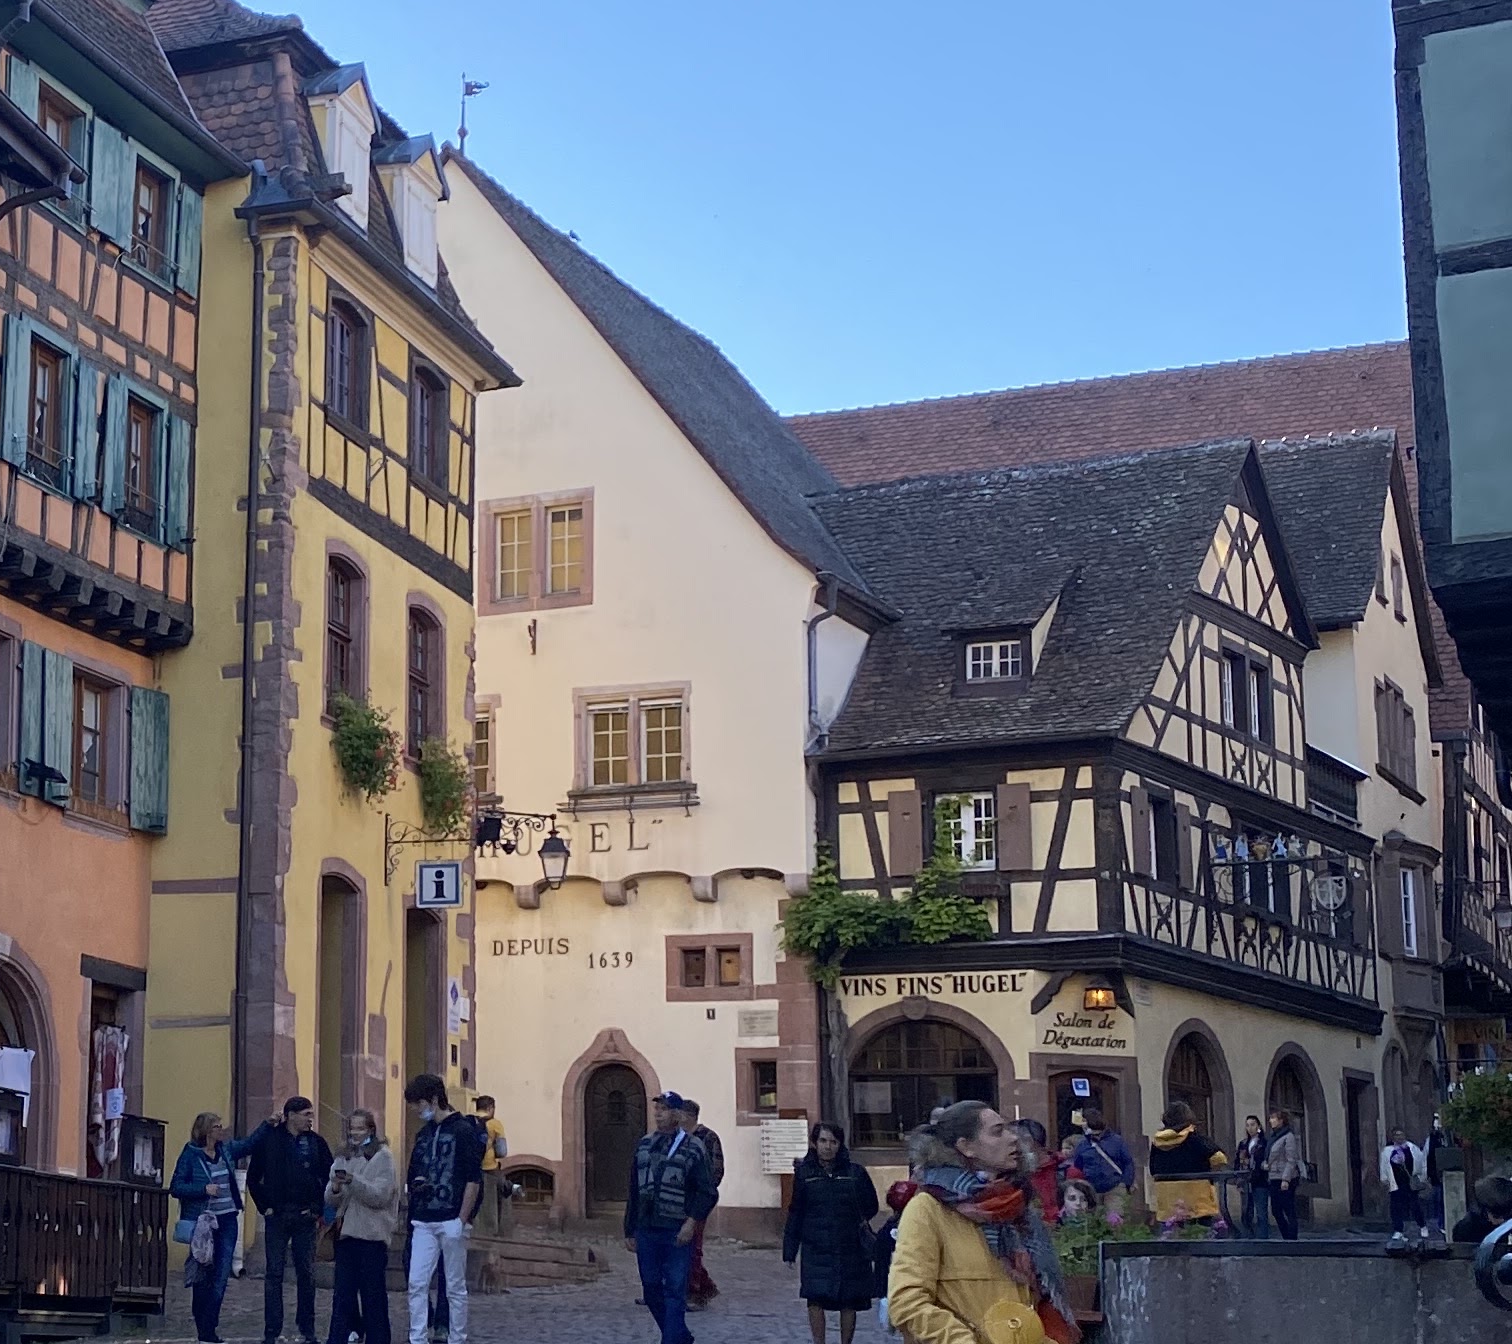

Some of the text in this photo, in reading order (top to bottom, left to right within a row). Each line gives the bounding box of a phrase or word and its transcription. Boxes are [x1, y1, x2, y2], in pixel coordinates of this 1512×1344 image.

[492, 938, 634, 969] DEPUIS 1639
[839, 977, 888, 997] VINS
[896, 976, 943, 996] FINS
[1053, 1012, 1116, 1030] Salon de
[1042, 1029, 1127, 1049] Dégustation
